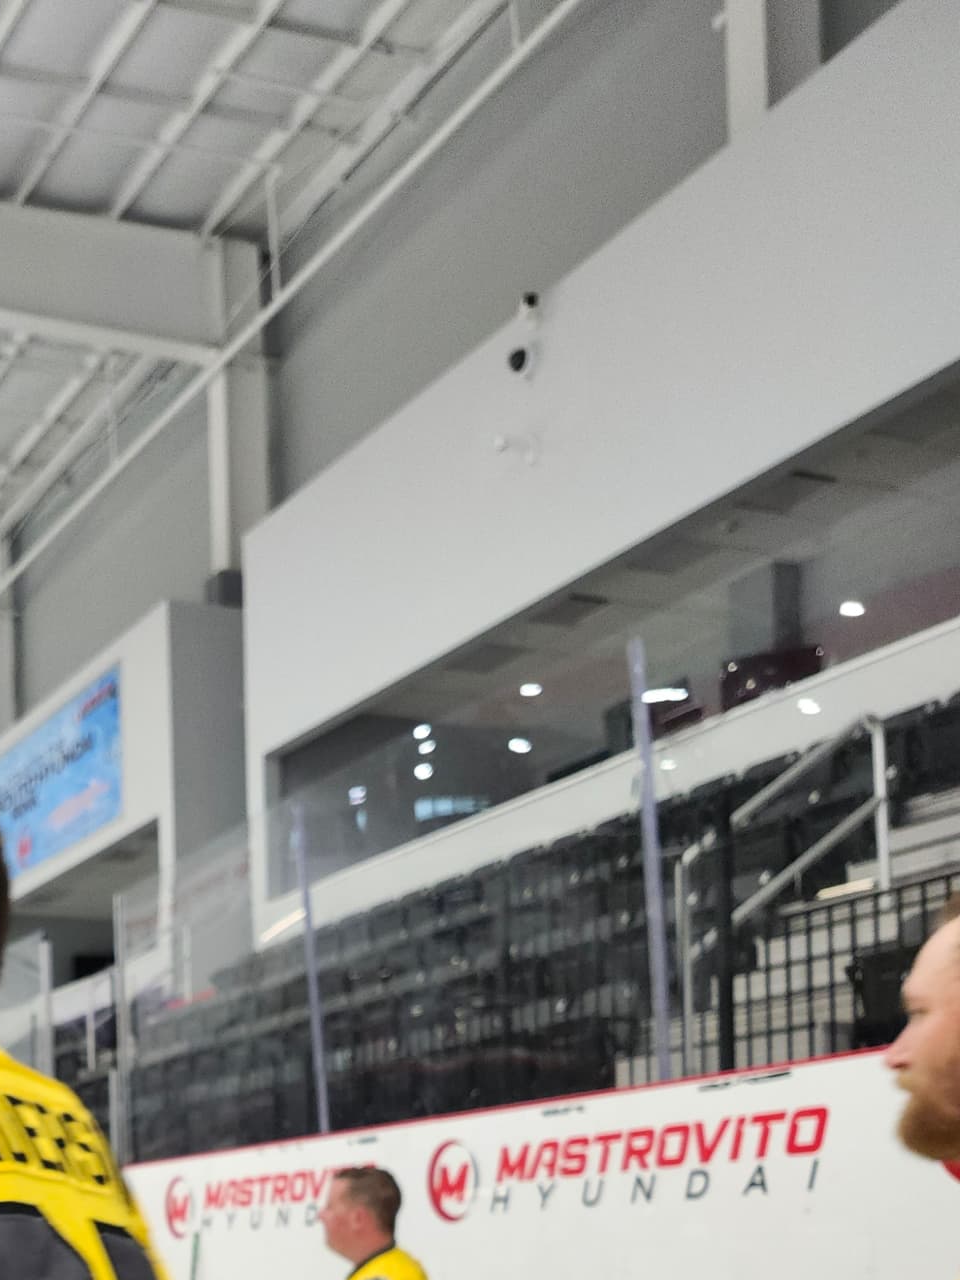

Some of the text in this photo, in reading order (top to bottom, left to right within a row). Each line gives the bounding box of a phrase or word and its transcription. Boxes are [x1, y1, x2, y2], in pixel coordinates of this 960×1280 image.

[495, 1106, 829, 1184] MASTROVITO
[204, 1161, 376, 1209] MASTROV
[489, 1158, 821, 1215] HYUNDAI
[201, 1203, 321, 1230] HYUND
